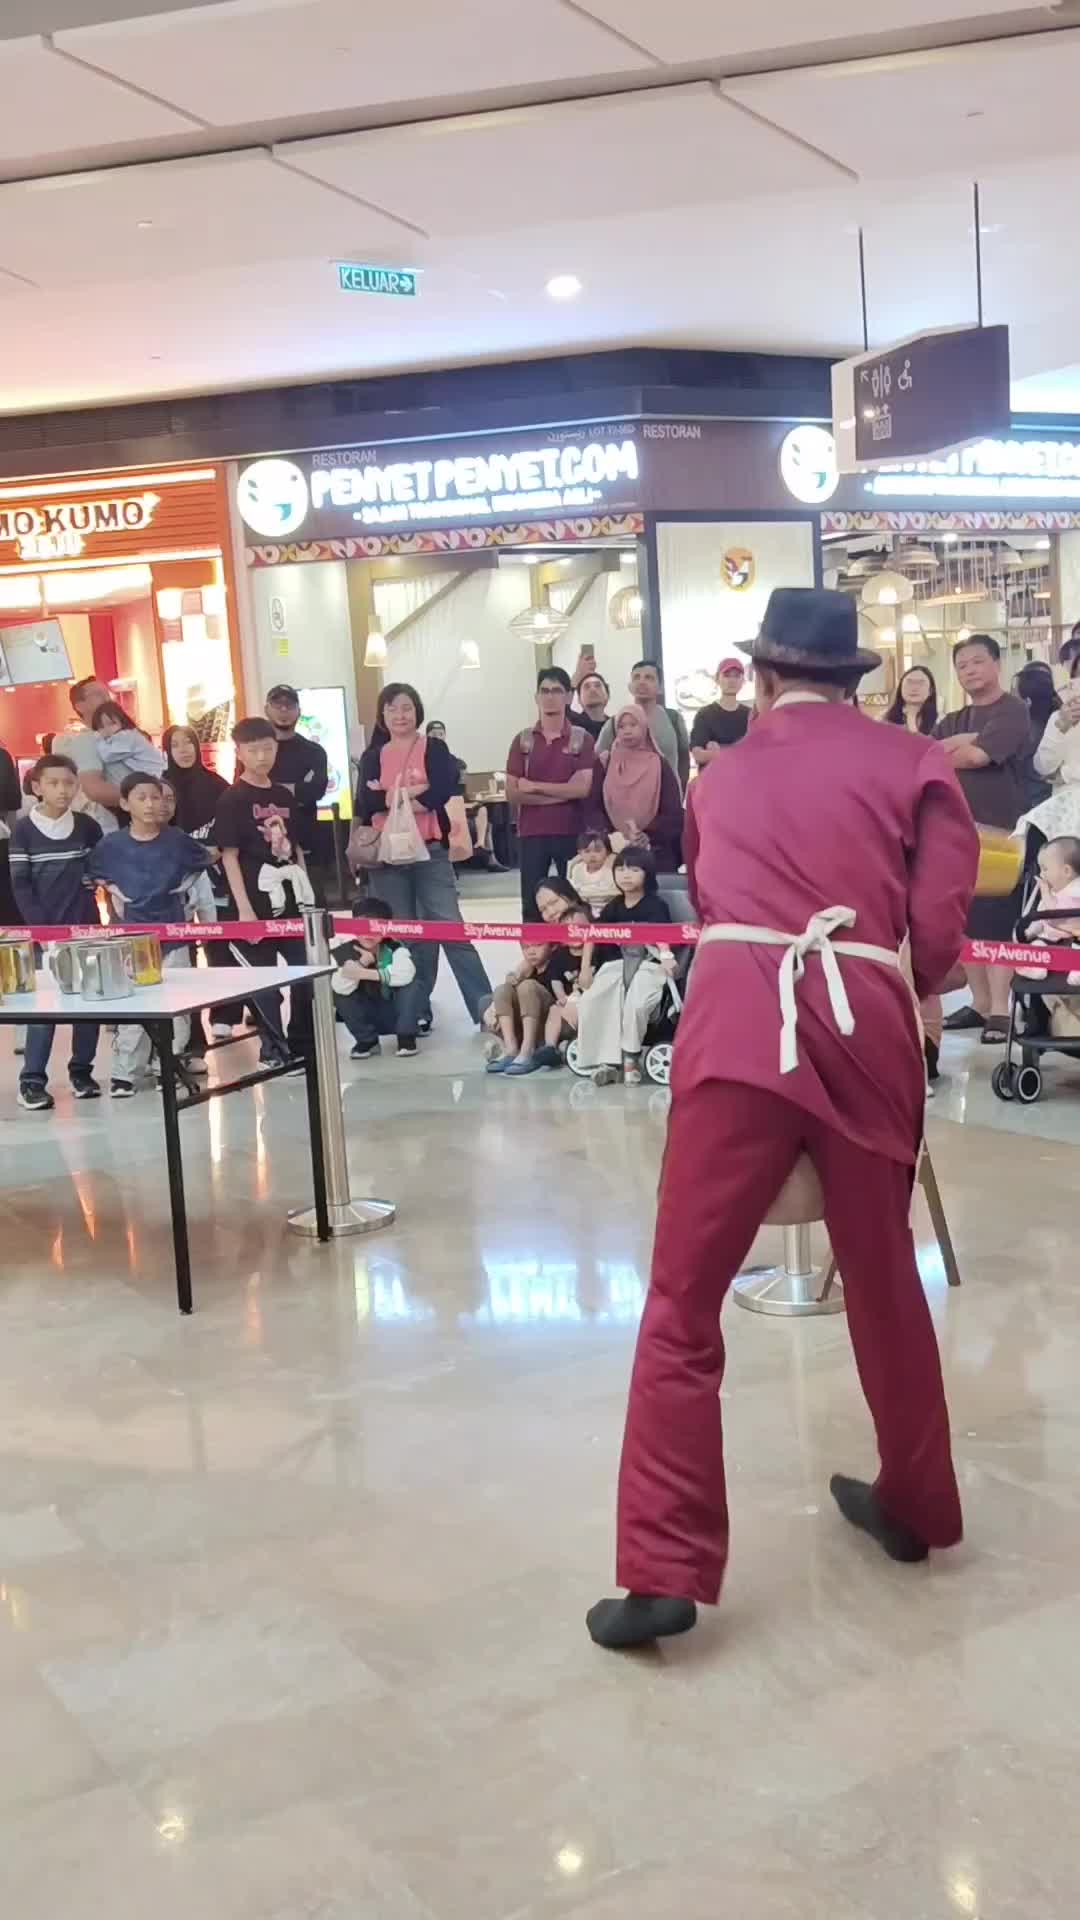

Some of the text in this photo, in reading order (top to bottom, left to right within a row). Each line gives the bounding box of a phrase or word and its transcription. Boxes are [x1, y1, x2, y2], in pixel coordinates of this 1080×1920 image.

[340, 266, 399, 293] KELUAR
[643, 424, 701, 439] RESTORAN
[312, 450, 376, 466] RESTORAN
[310, 460, 423, 509] PENYET
[43, 501, 144, 533] KUMO
[166, 924, 223, 938] SkyAvenue
[265, 921, 304, 935] SkyAve
[369, 920, 632, 941] SkyAvenue SkyAvenue SkyAvenue
[971, 941, 1051, 964] SkyAvenue
